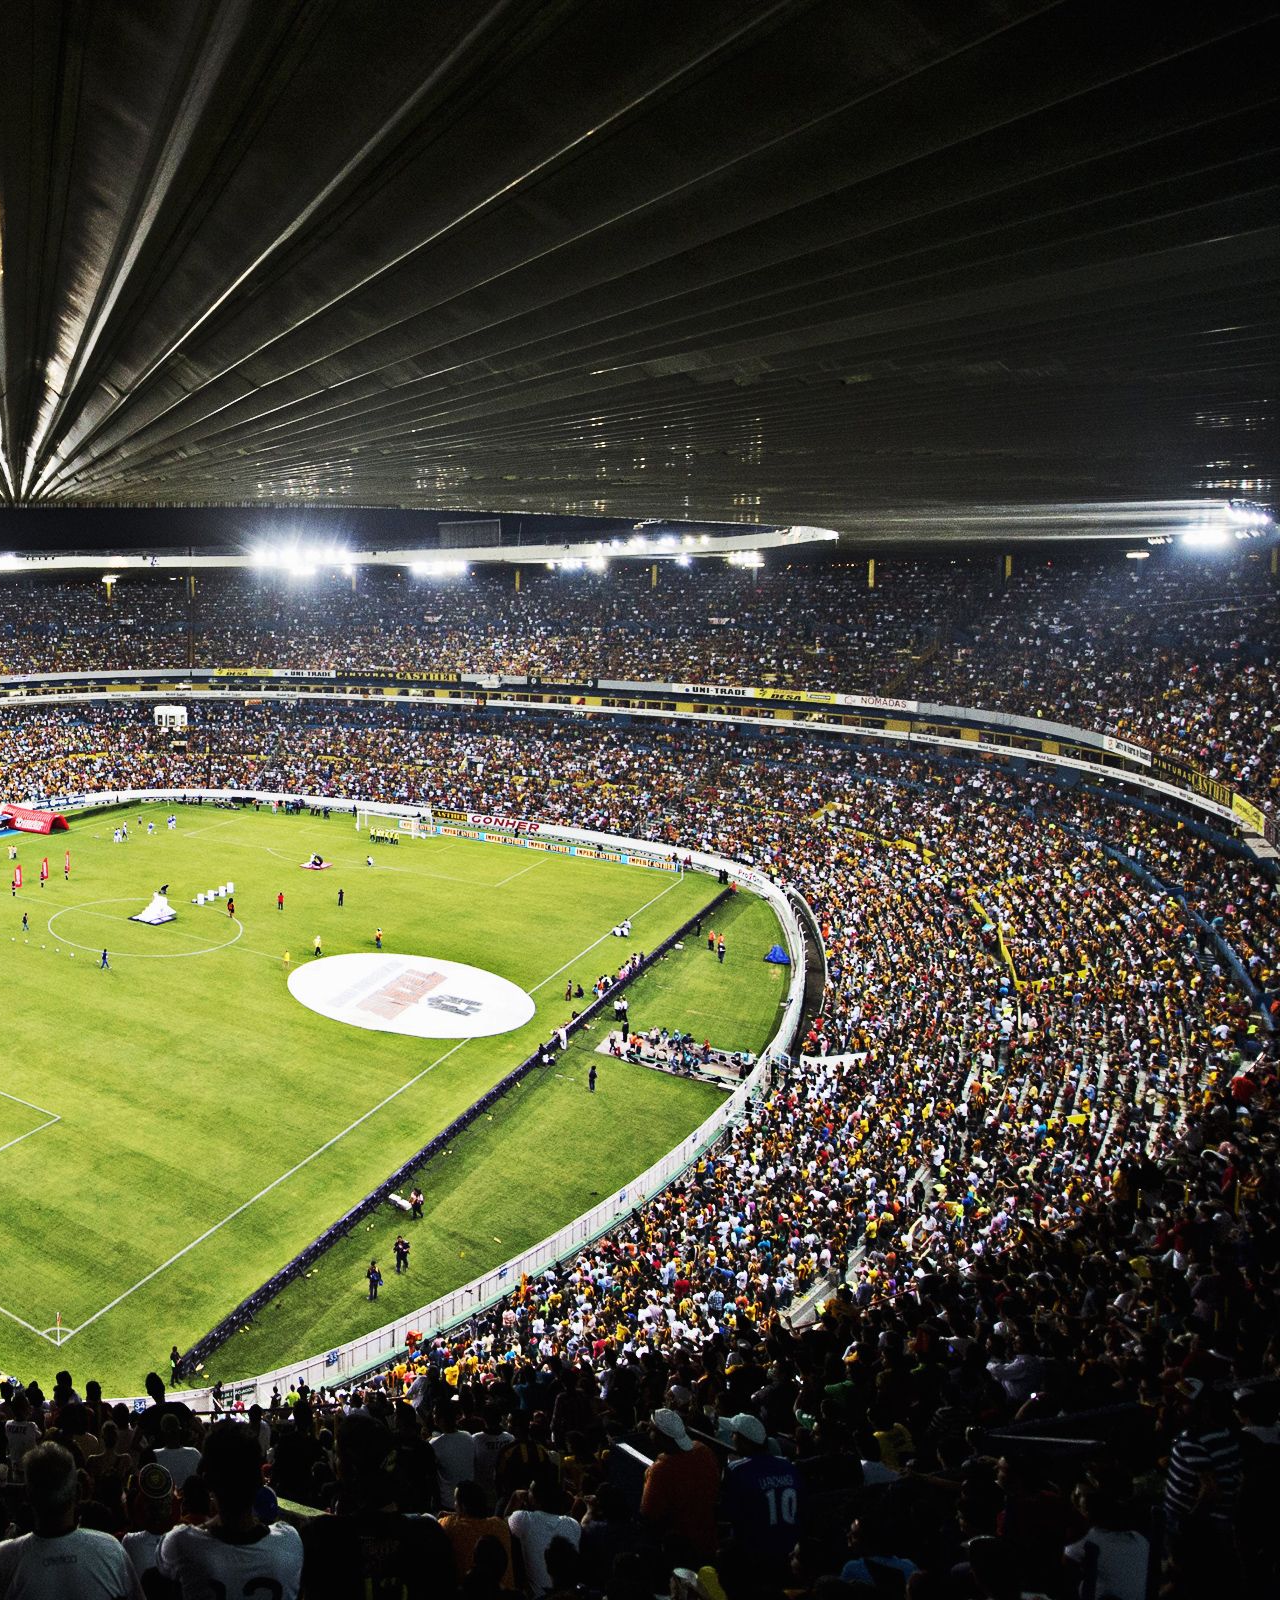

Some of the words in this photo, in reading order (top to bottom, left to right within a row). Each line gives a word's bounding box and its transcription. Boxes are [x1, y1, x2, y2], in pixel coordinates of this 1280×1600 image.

[395, 671, 458, 682] CASTHER
[692, 686, 747, 696] UNI-TRADE
[861, 696, 907, 709] NOMADAS
[1153, 757, 1192, 782] PINTURAS
[1192, 772, 1231, 807] CASTHER
[471, 814, 540, 832] GONHER
[134, 1401, 145, 1410] 34
[766, 1488, 797, 1525] 10
